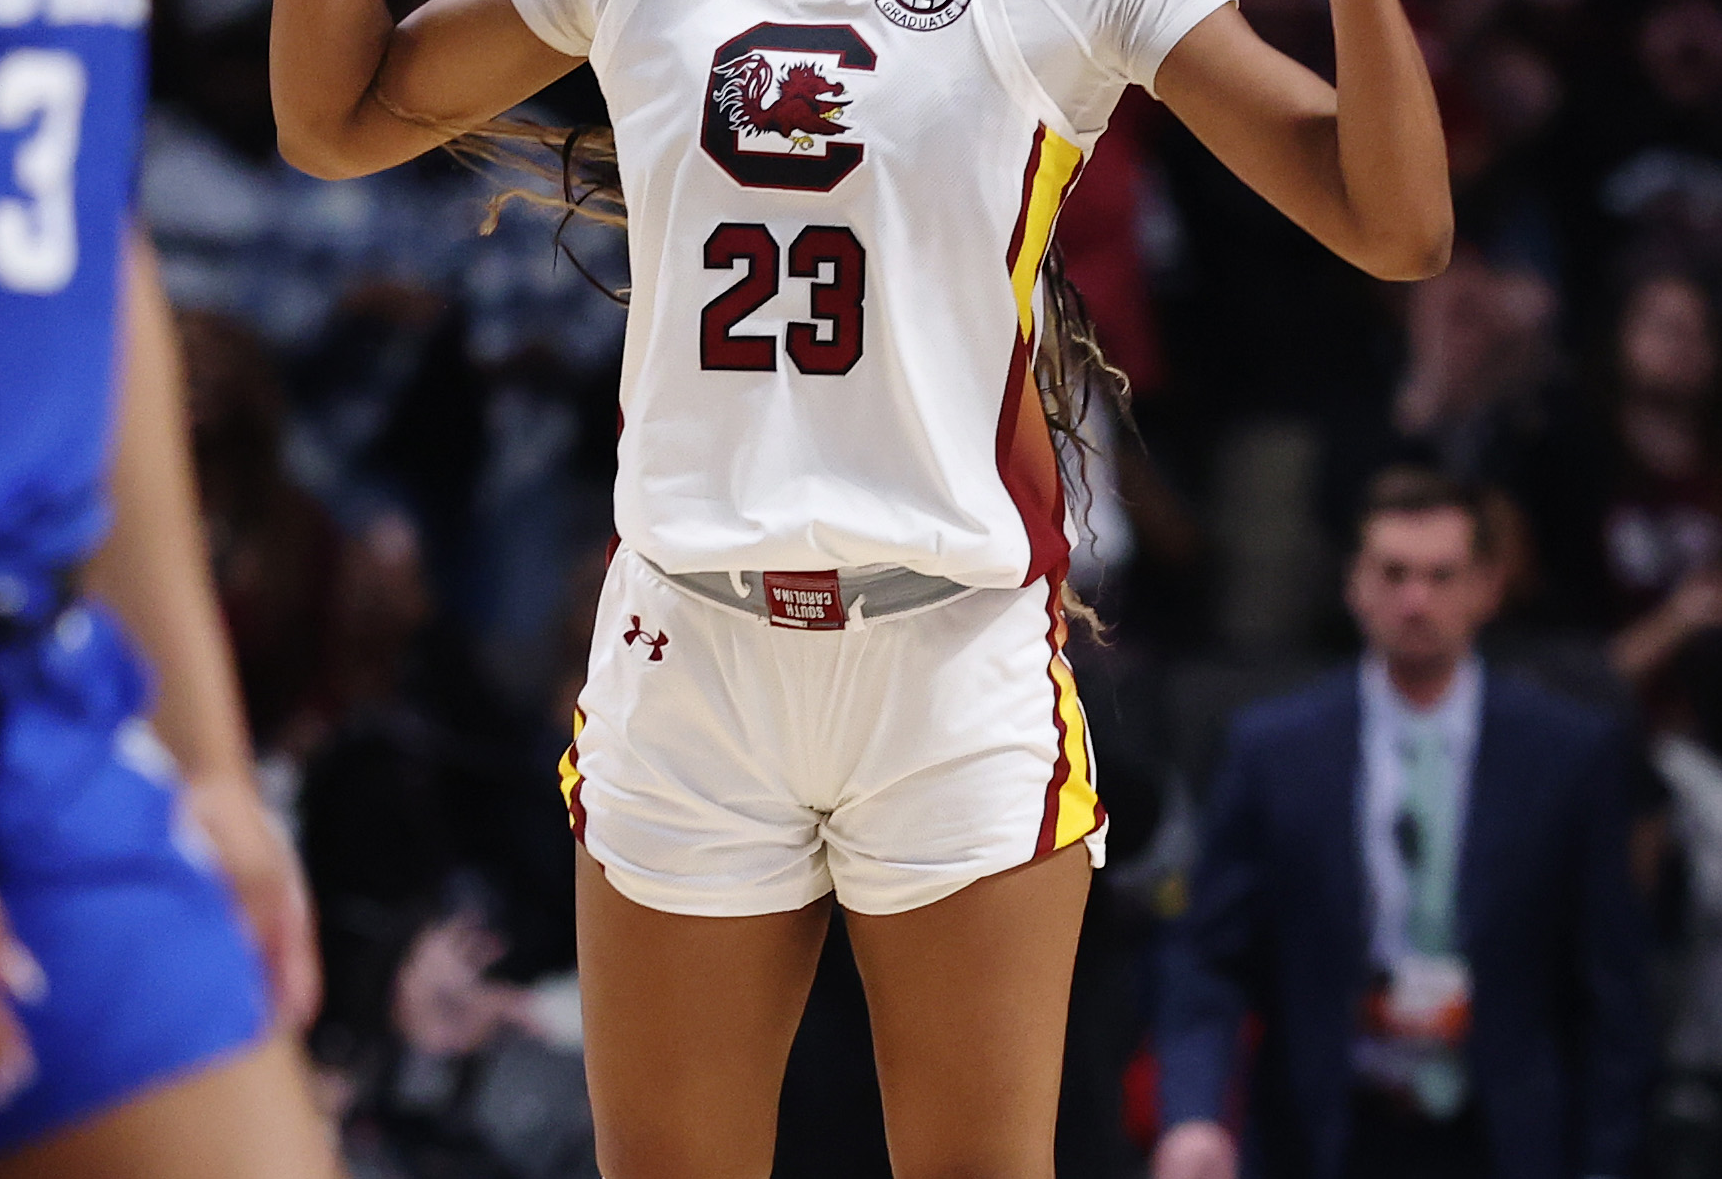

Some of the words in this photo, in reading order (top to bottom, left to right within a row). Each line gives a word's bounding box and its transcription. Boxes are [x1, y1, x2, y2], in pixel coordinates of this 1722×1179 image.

[883, 2, 956, 29] GRADUATE
[700, 222, 866, 376] 23
[772, 587, 833, 606] CAROLINA
[785, 604, 826, 619] SOUTH
